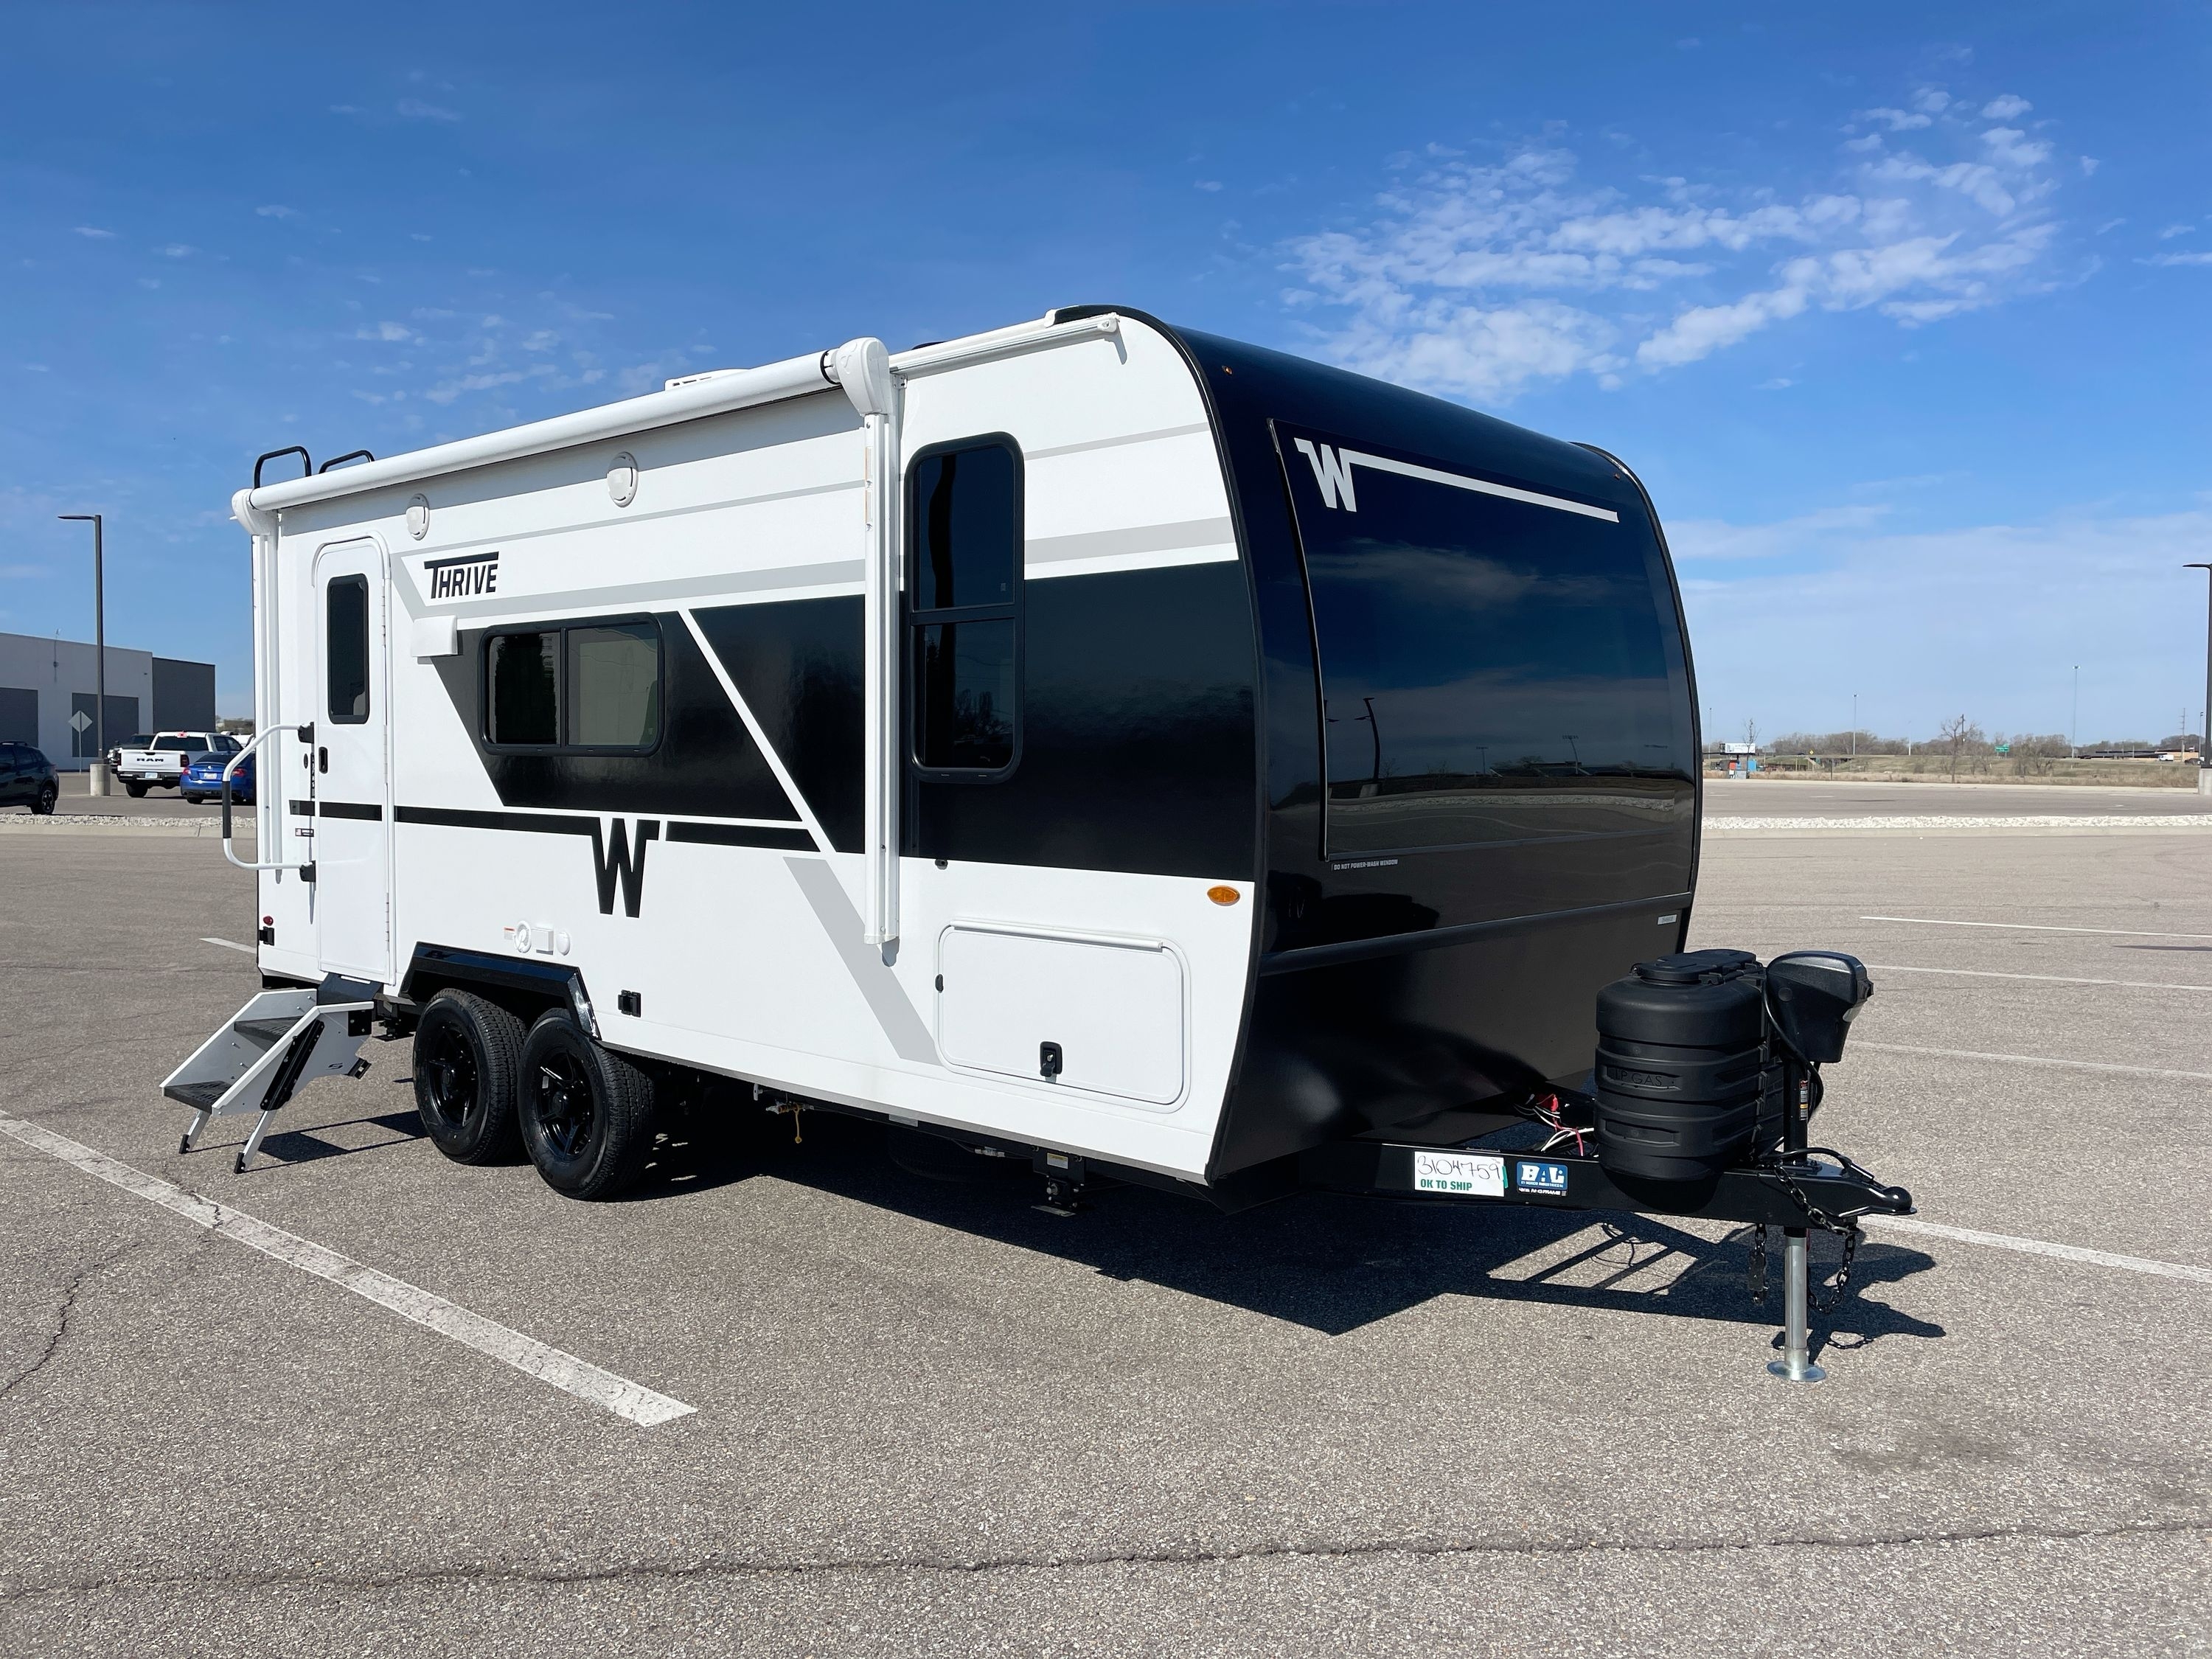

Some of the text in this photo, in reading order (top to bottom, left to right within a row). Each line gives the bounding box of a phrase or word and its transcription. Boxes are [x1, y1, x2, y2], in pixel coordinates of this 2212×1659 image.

[424, 551, 499, 599] THRIVE
[1631, 1073, 1662, 1087] GAS
[1417, 1155, 1501, 1180] 3104759
[1521, 1164, 1565, 1184] BAL
[1420, 1178, 1472, 1191] OK TO SHIP
